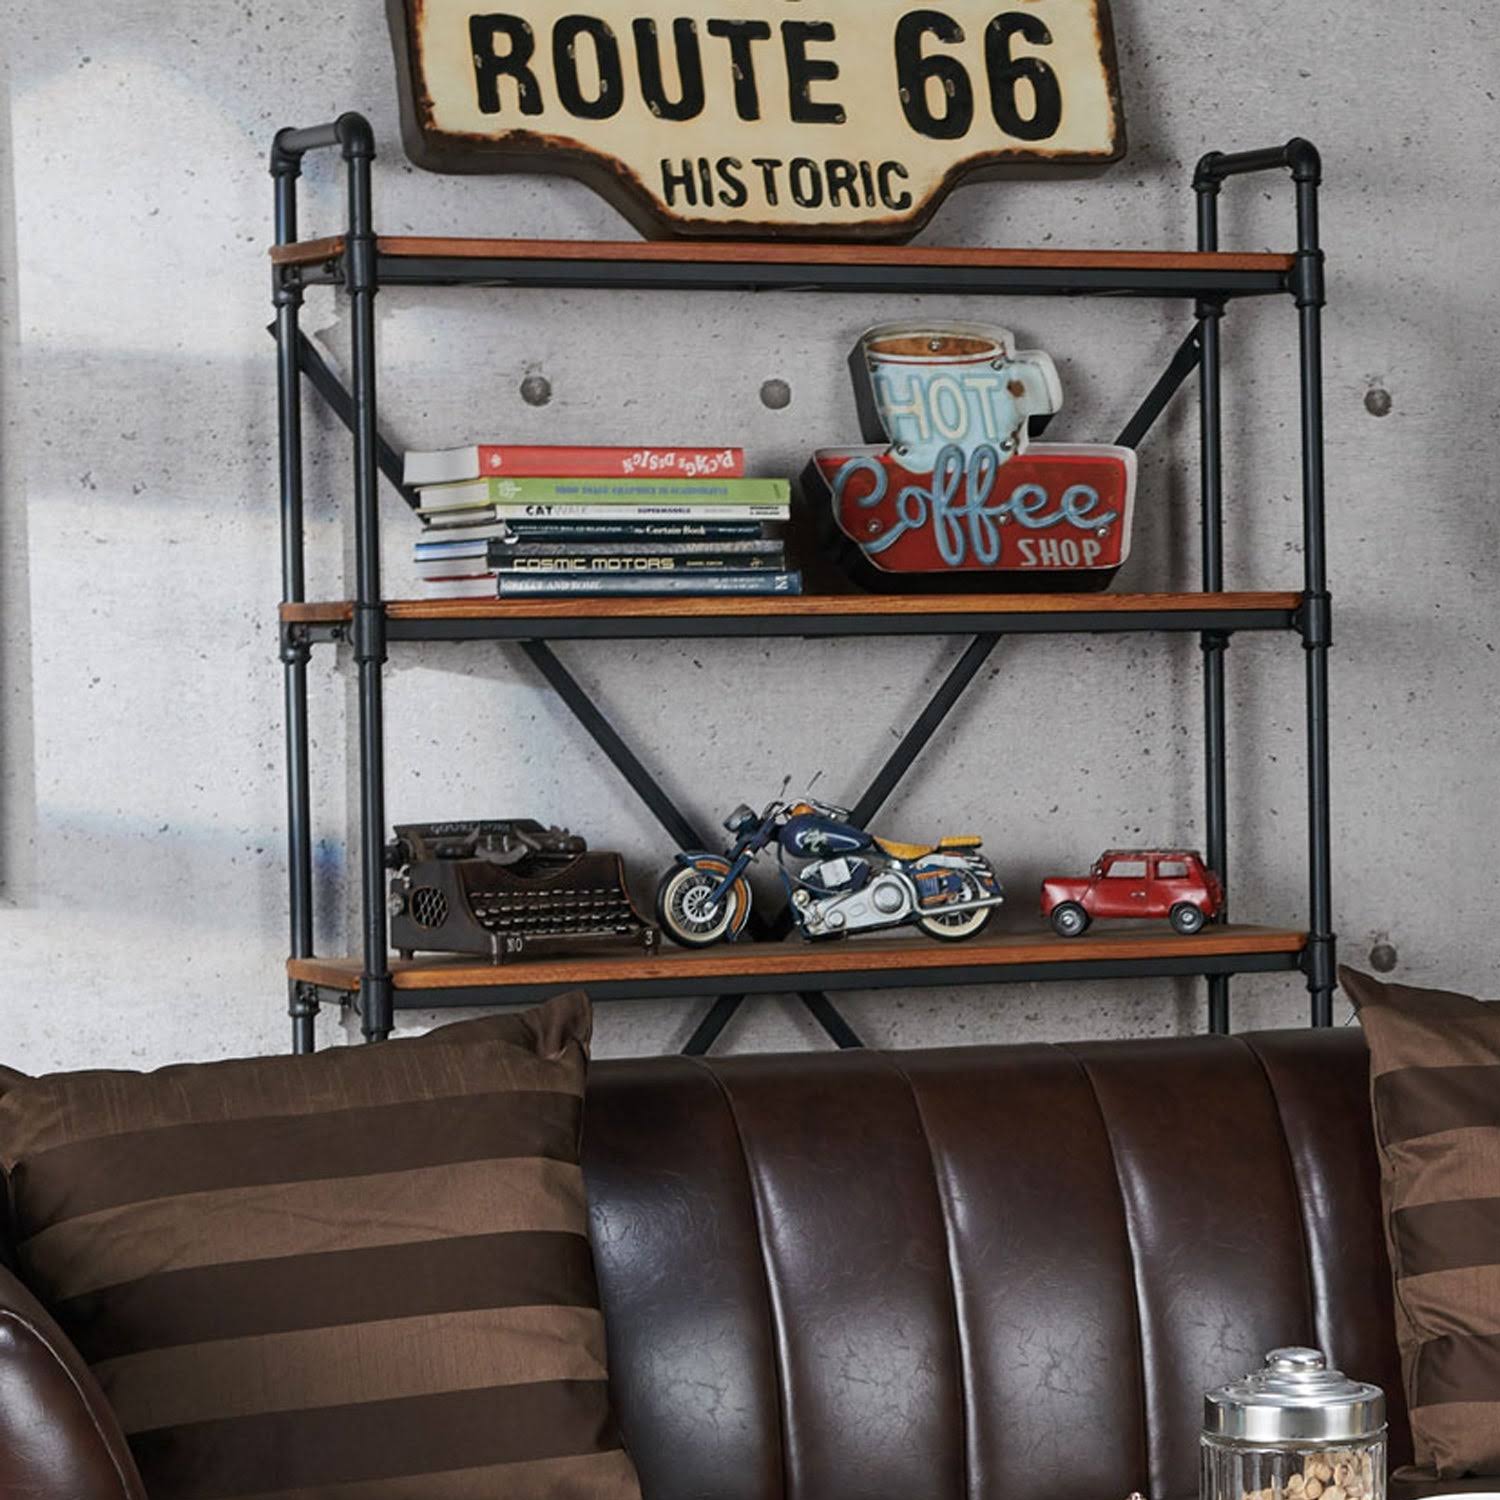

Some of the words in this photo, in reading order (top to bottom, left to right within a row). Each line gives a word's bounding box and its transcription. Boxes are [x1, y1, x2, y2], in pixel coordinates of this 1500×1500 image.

[468, 13, 847, 125] ROUTE
[893, 9, 1063, 141] 66
[660, 156, 914, 211] HISTORIC
[875, 374, 1001, 443] HOT
[832, 444, 1118, 565] Coffee
[513, 558, 587, 570] COSMIC
[592, 557, 675, 570] MOTORS
[1017, 538, 1102, 567] SHOP
